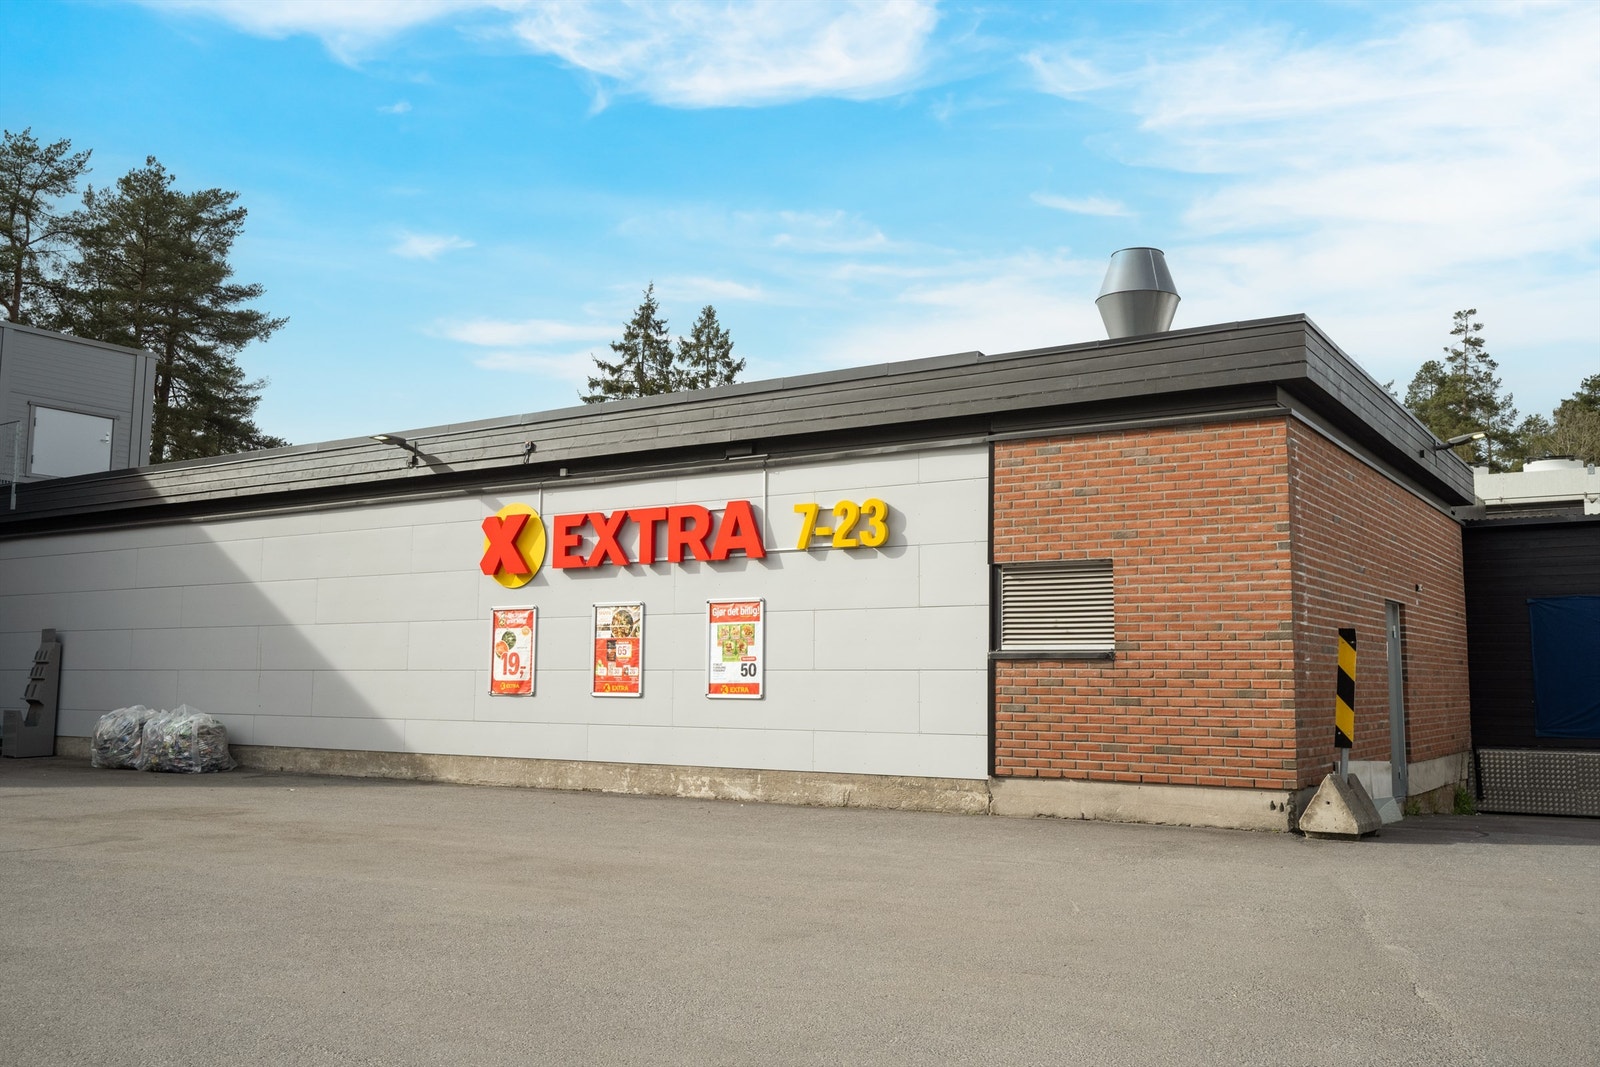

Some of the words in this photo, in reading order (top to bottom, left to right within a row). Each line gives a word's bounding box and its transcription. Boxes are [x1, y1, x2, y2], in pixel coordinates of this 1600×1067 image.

[552, 500, 767, 569] EXTRA
[793, 497, 890, 550] 7-23
[727, 607, 739, 616] det
[740, 662, 757, 677] 50
